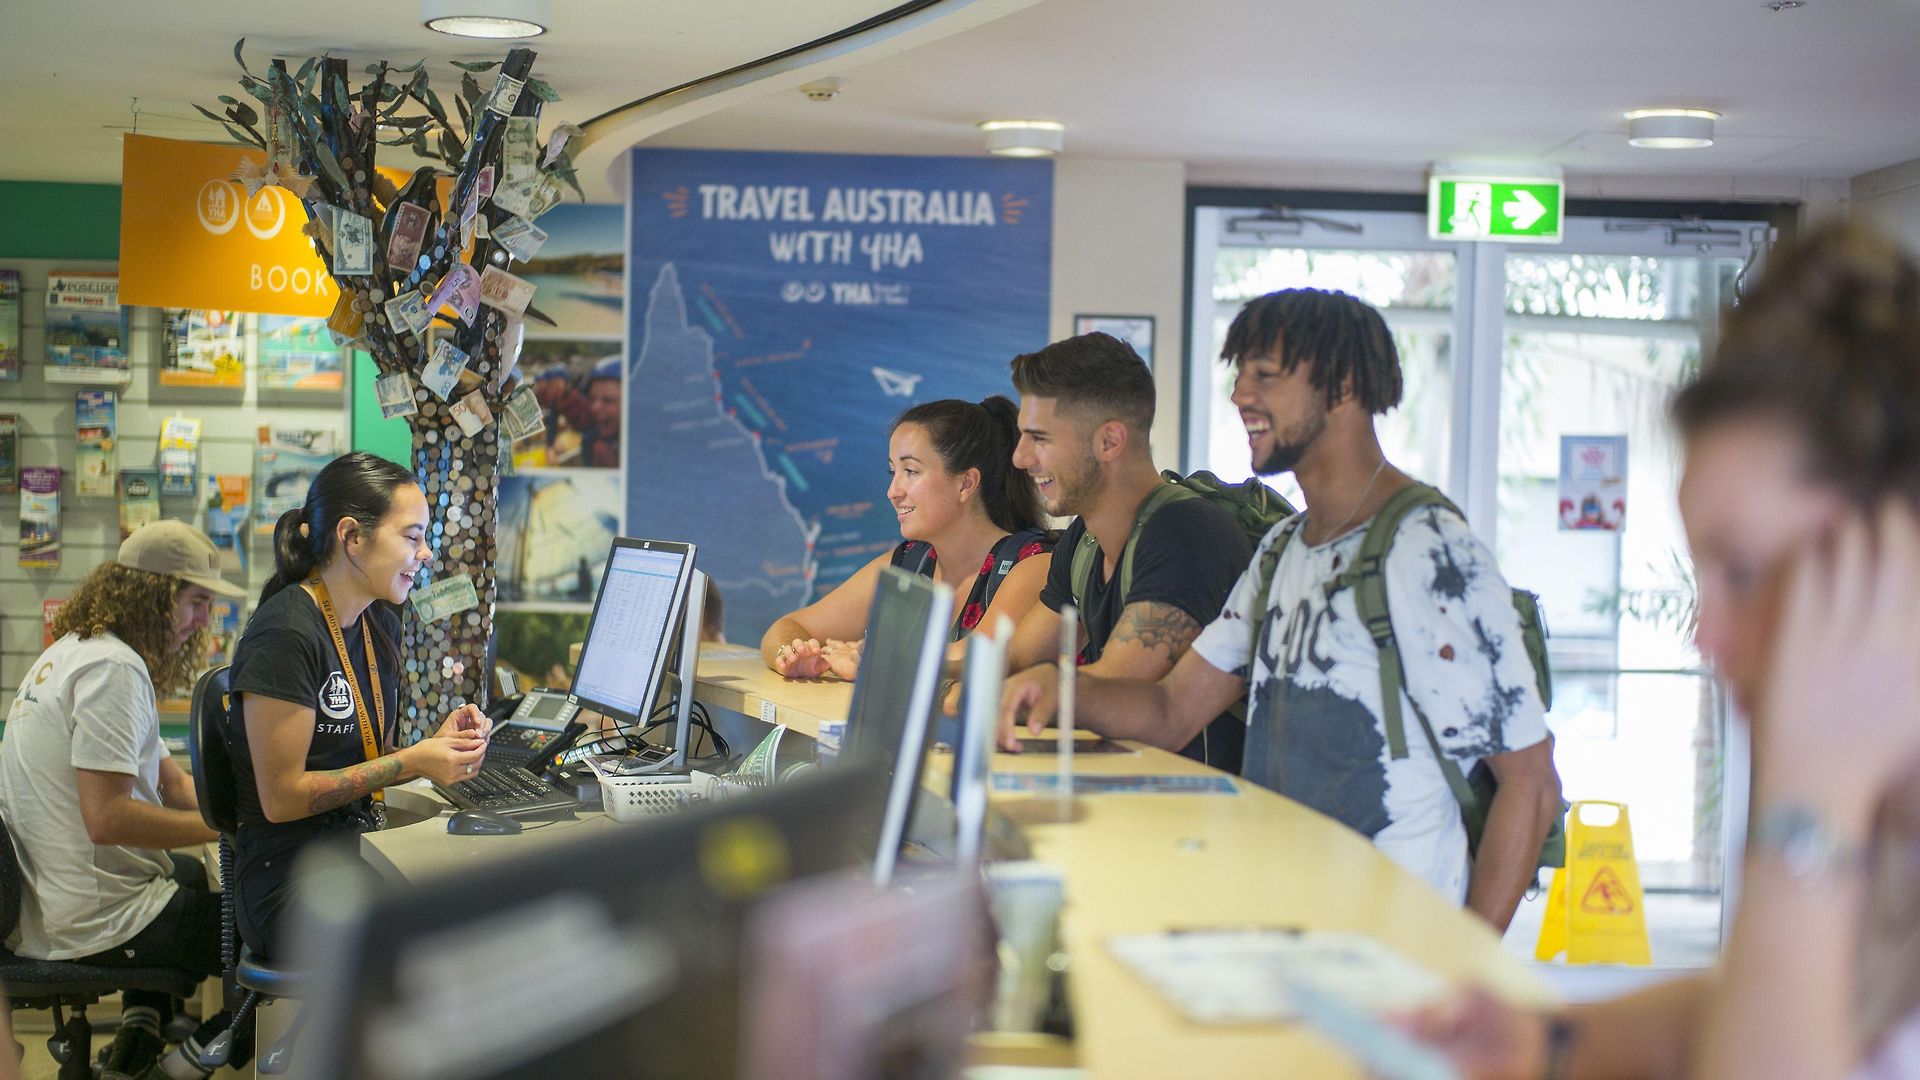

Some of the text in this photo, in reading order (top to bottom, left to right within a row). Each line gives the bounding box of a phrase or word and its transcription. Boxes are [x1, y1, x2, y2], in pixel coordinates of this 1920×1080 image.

[698, 184, 996, 226] TRAVEL AUSTRALIA
[769, 230, 924, 272] WITH YHA
[67, 281, 119, 294] POSEIDO
[250, 263, 329, 297] BOOK
[322, 600, 333, 613] SEE
[328, 613, 345, 652] AUSTRALIA
[364, 730, 373, 746] YHA
[328, 696, 349, 704] YHA
[316, 723, 355, 734] STAFF
